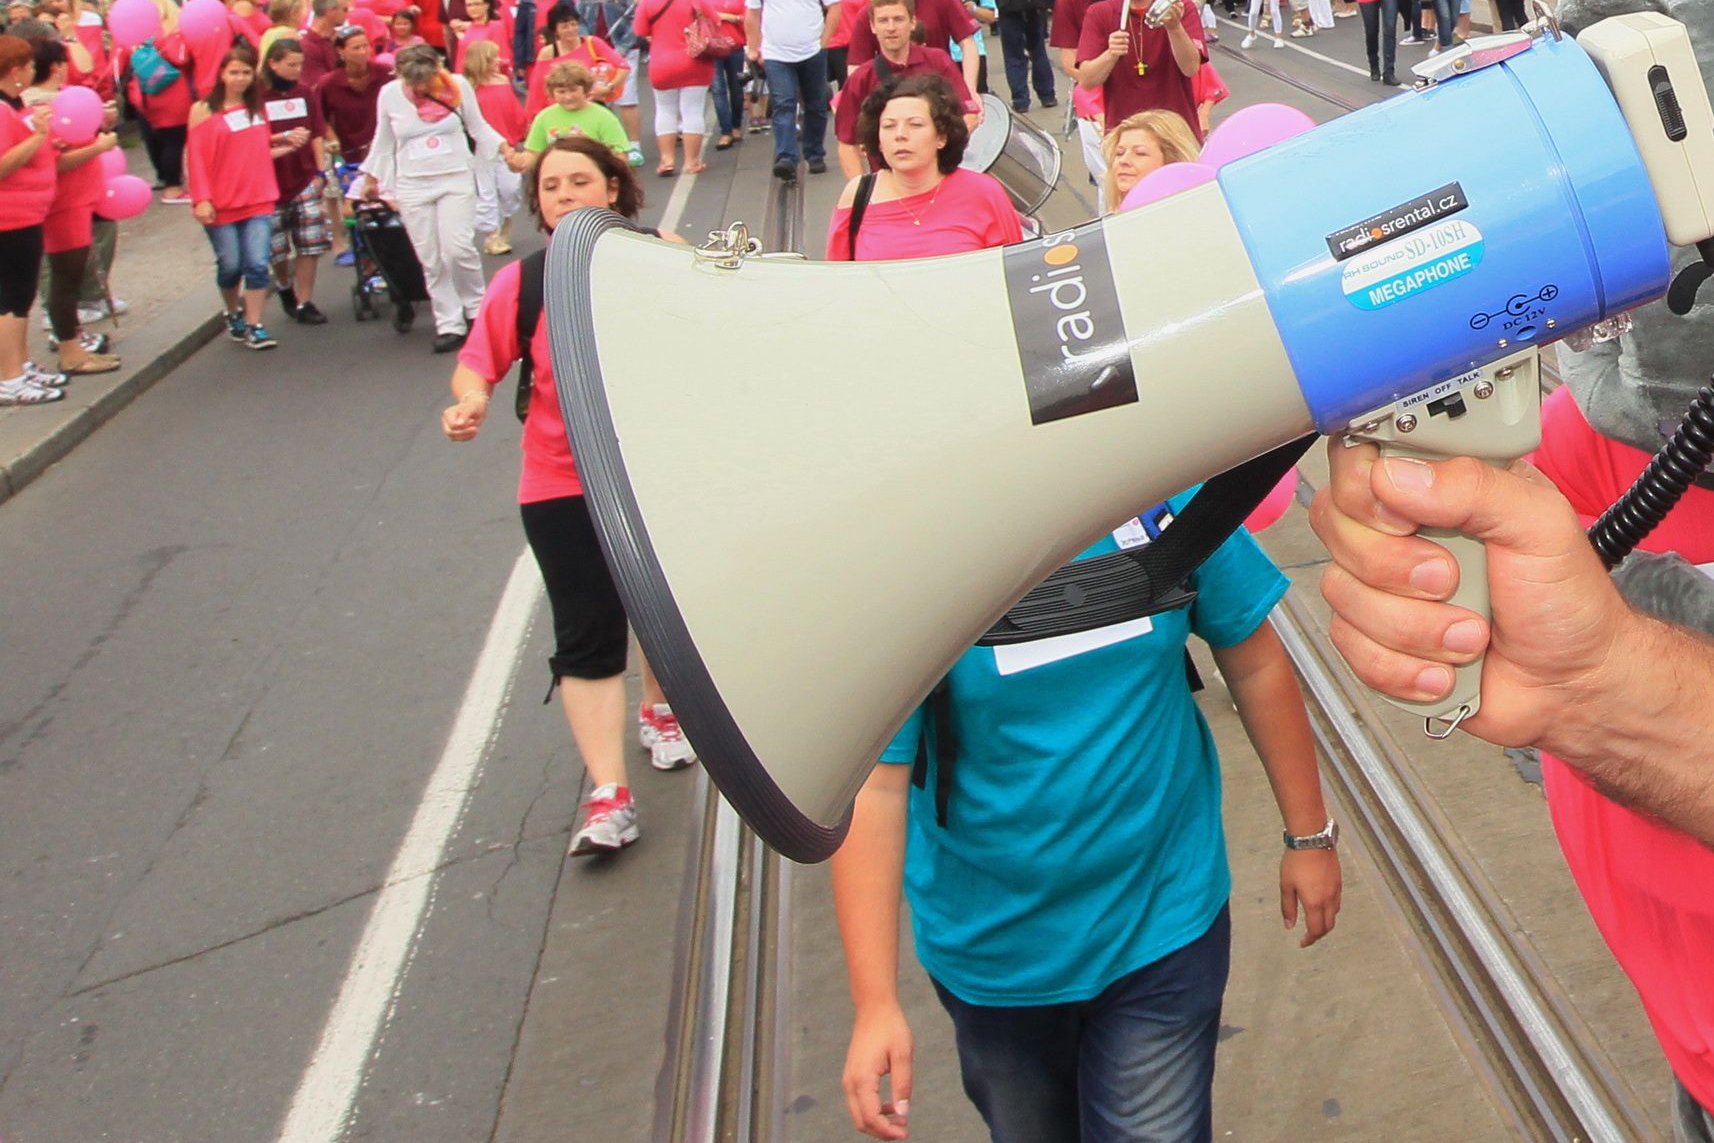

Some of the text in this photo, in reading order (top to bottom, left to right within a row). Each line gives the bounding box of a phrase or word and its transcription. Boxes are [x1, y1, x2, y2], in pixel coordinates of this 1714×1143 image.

[1339, 194, 1458, 253] radiosrental.cz
[1363, 250, 1404, 273] SOUND
[1405, 221, 1467, 260] SD-10SH
[1368, 252, 1472, 306] MEGAPHONE
[1503, 307, 1546, 330] DC 12V
[1403, 371, 1481, 408] SIREN OFF TALK
